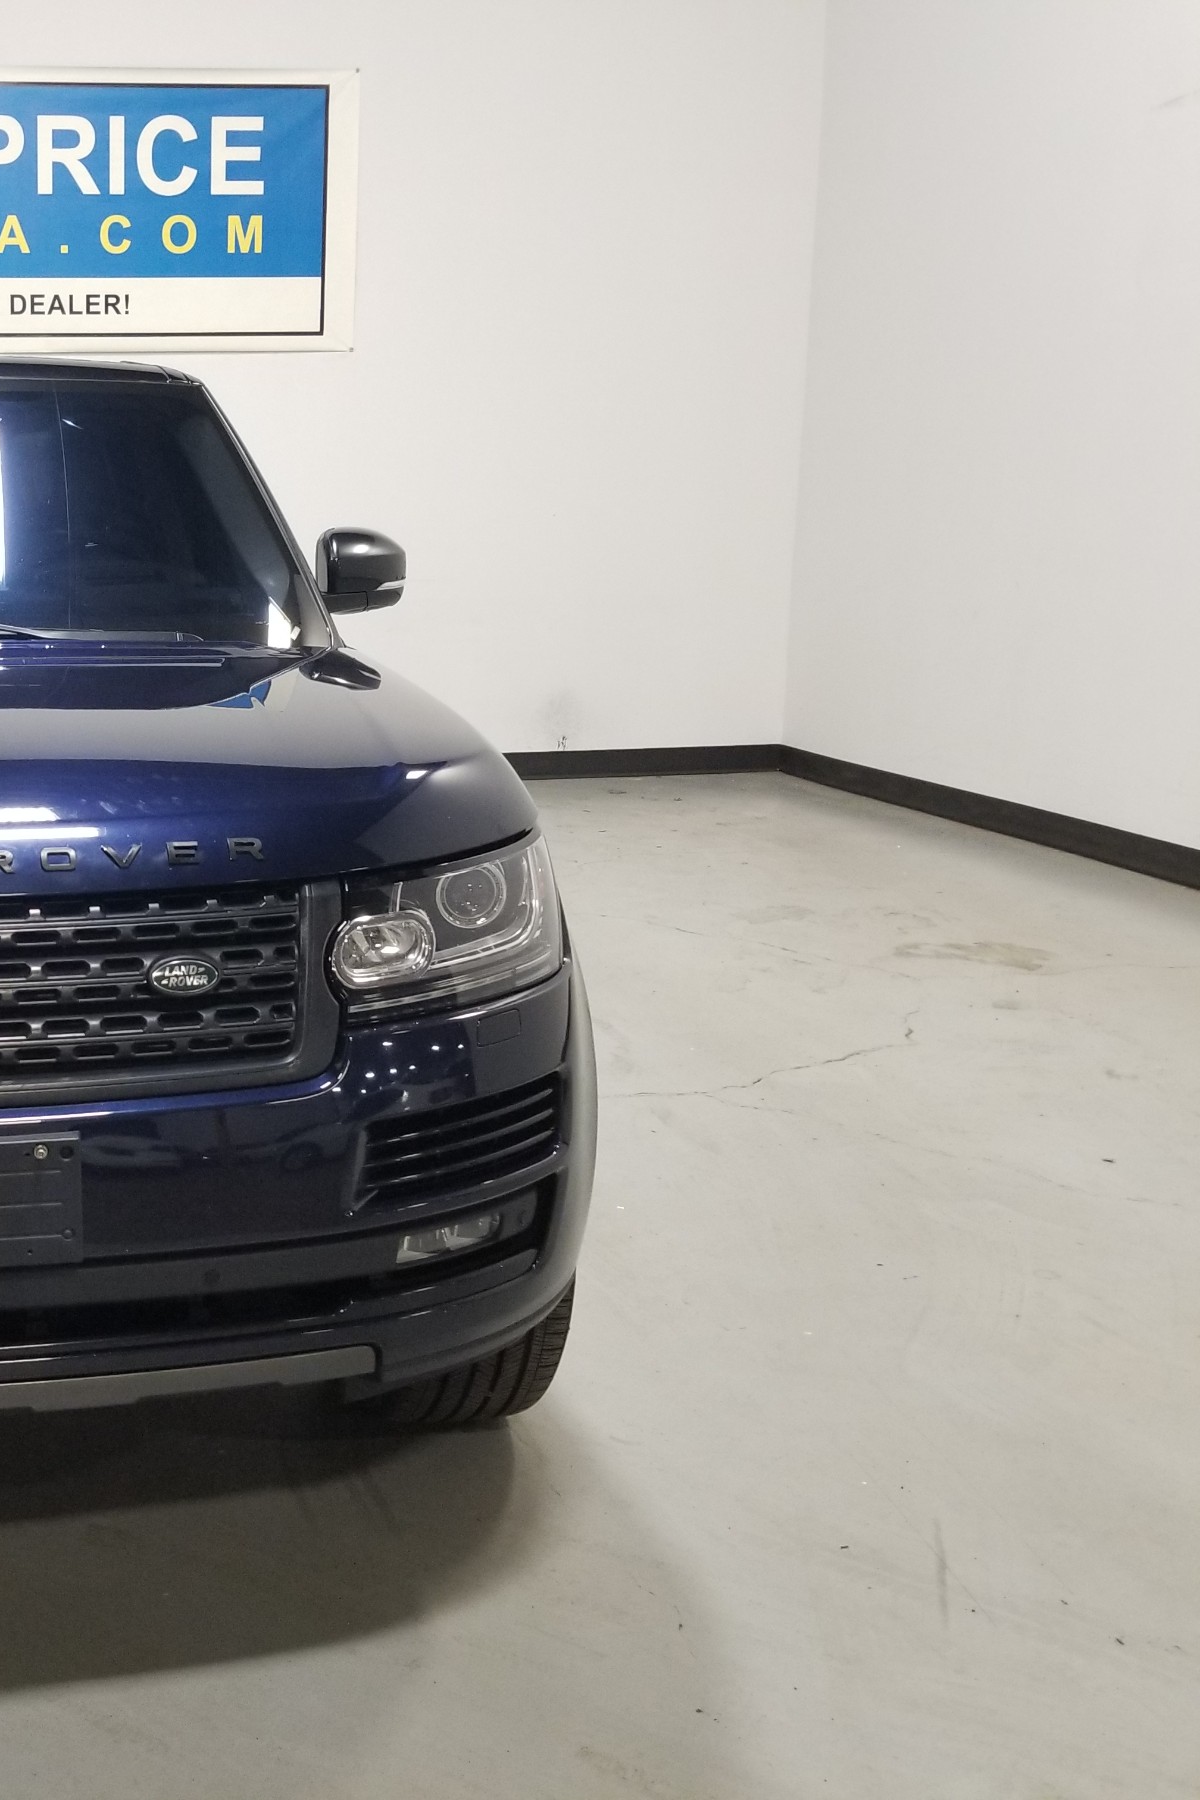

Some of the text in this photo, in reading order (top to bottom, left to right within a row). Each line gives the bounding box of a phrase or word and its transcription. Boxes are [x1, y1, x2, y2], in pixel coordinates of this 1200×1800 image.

[10, 293, 131, 316] DEALER!
[164, 965, 197, 976] LAND
[168, 975, 209, 987] ROVER
